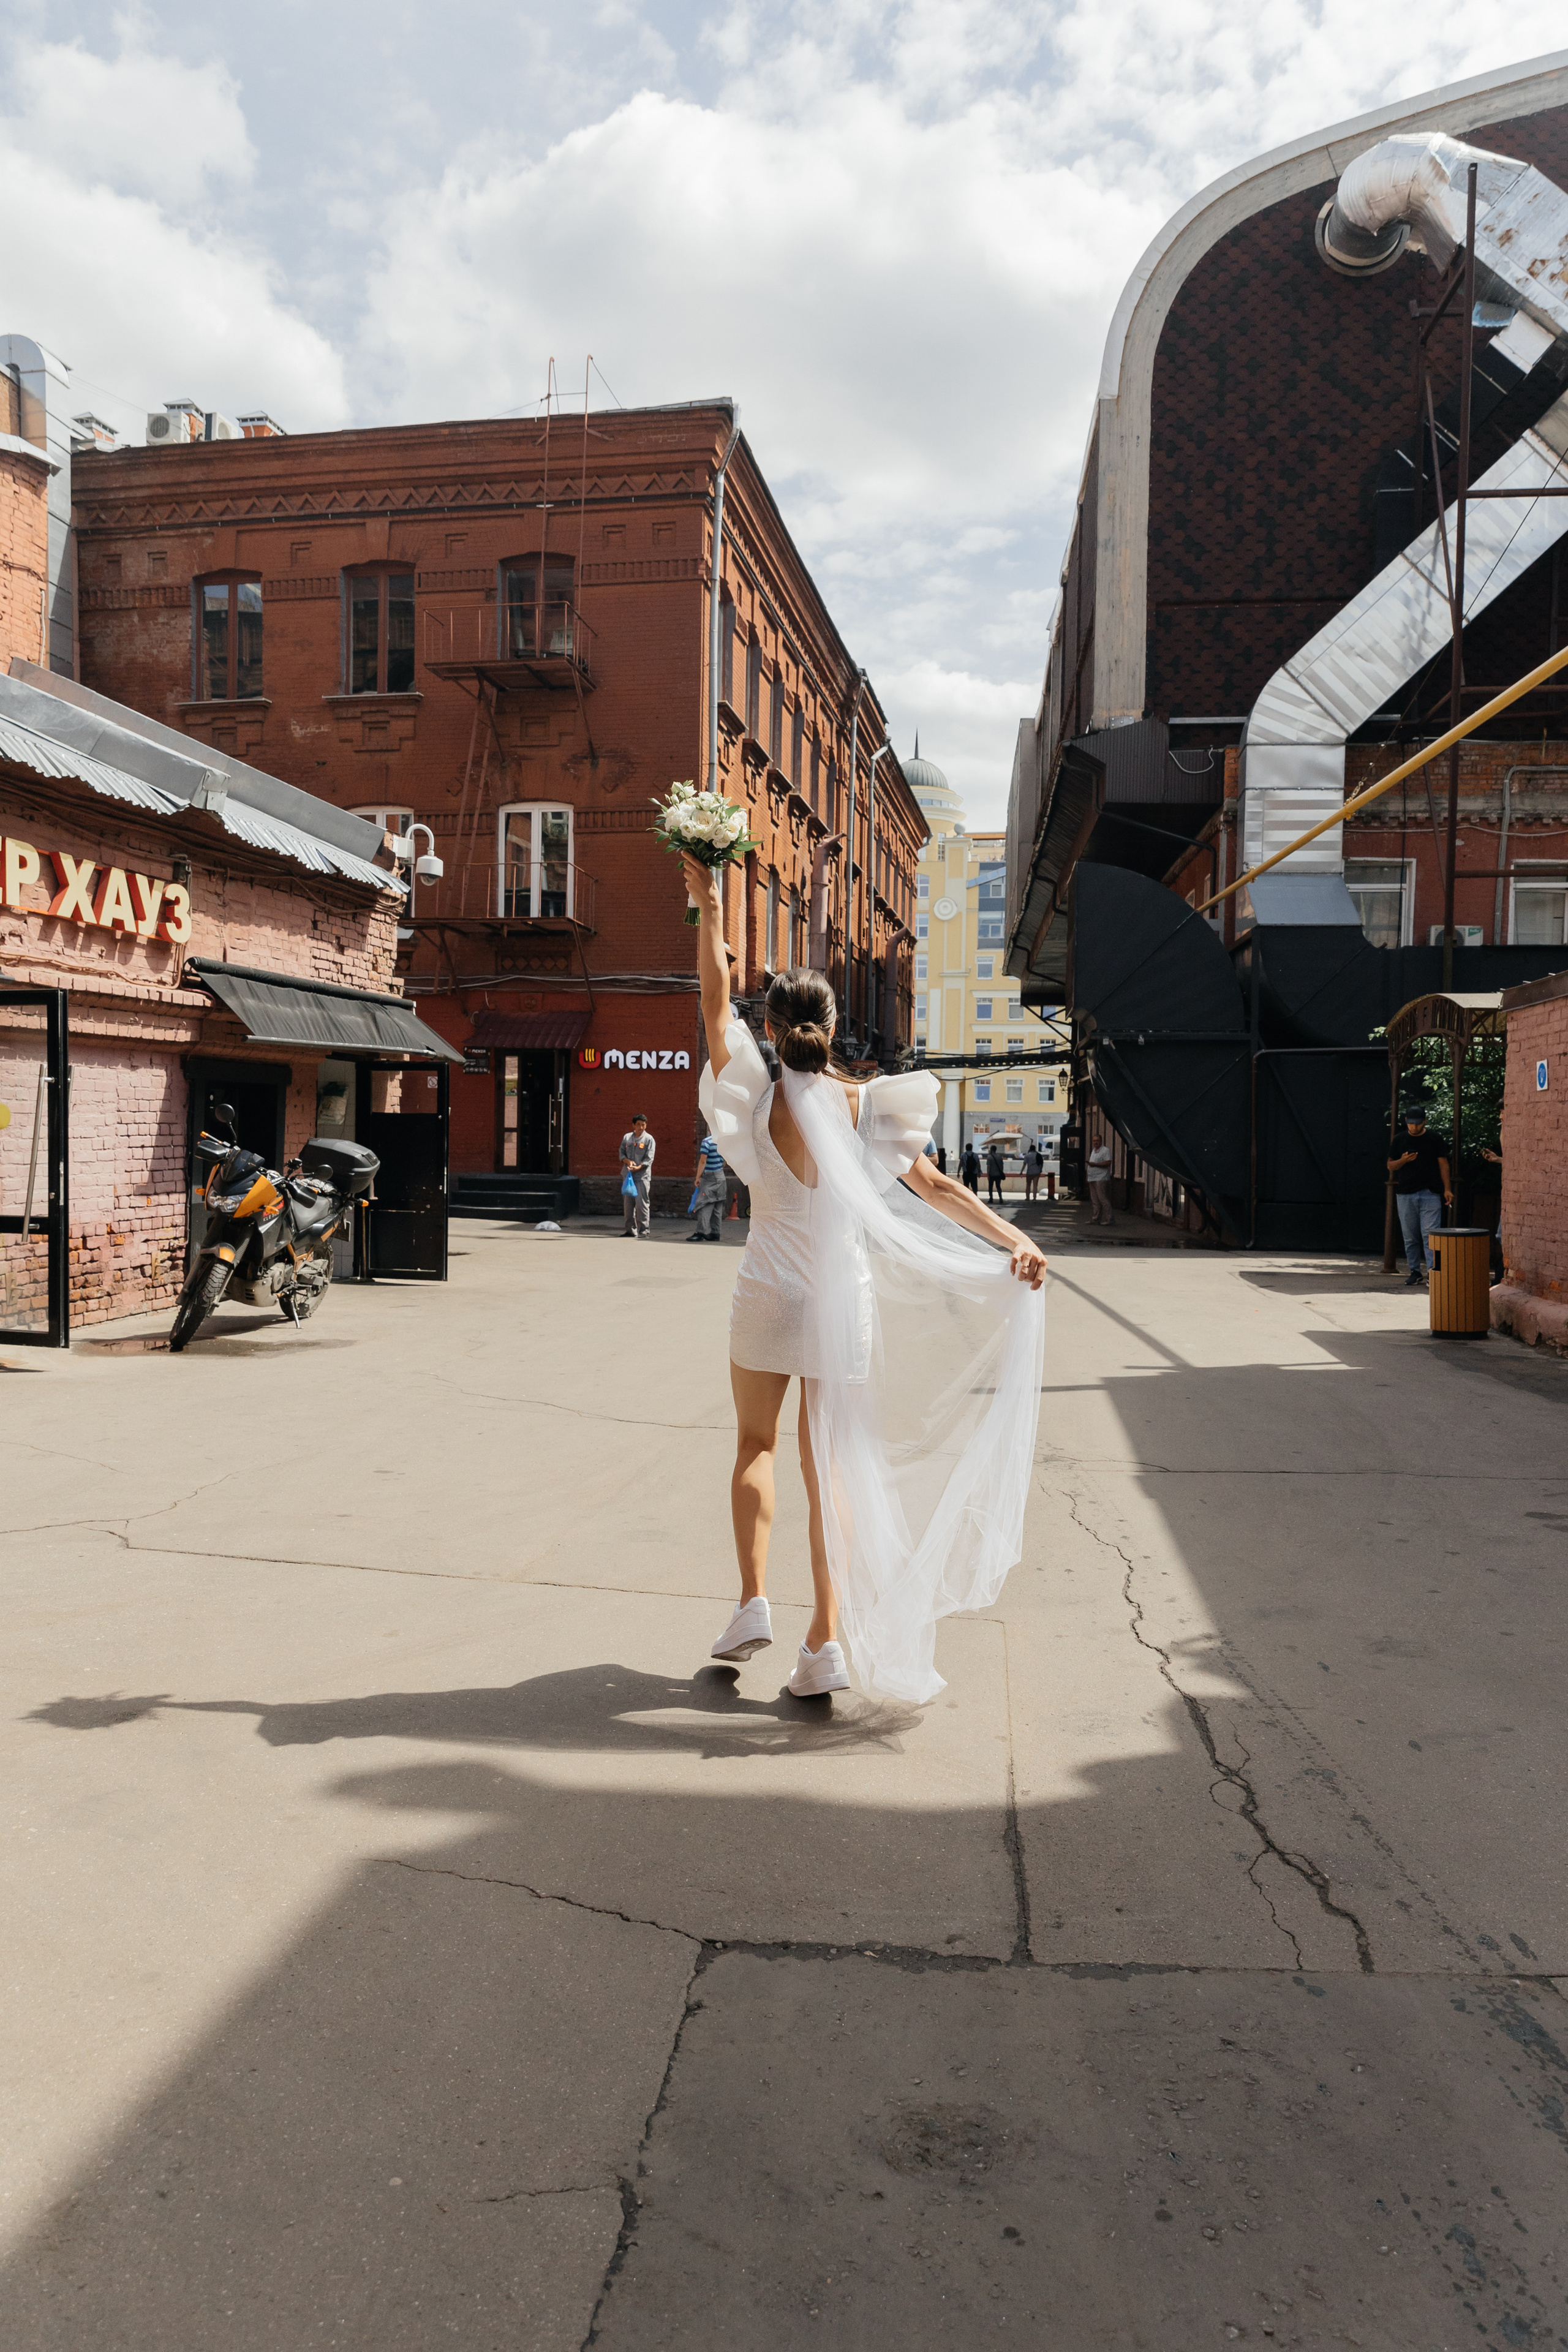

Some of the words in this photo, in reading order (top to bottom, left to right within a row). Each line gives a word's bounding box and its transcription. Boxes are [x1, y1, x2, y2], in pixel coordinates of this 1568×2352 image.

[0, 835, 40, 907] Р
[56, 851, 192, 944] ХАУЗ
[604, 1049, 690, 1069] MENZA
